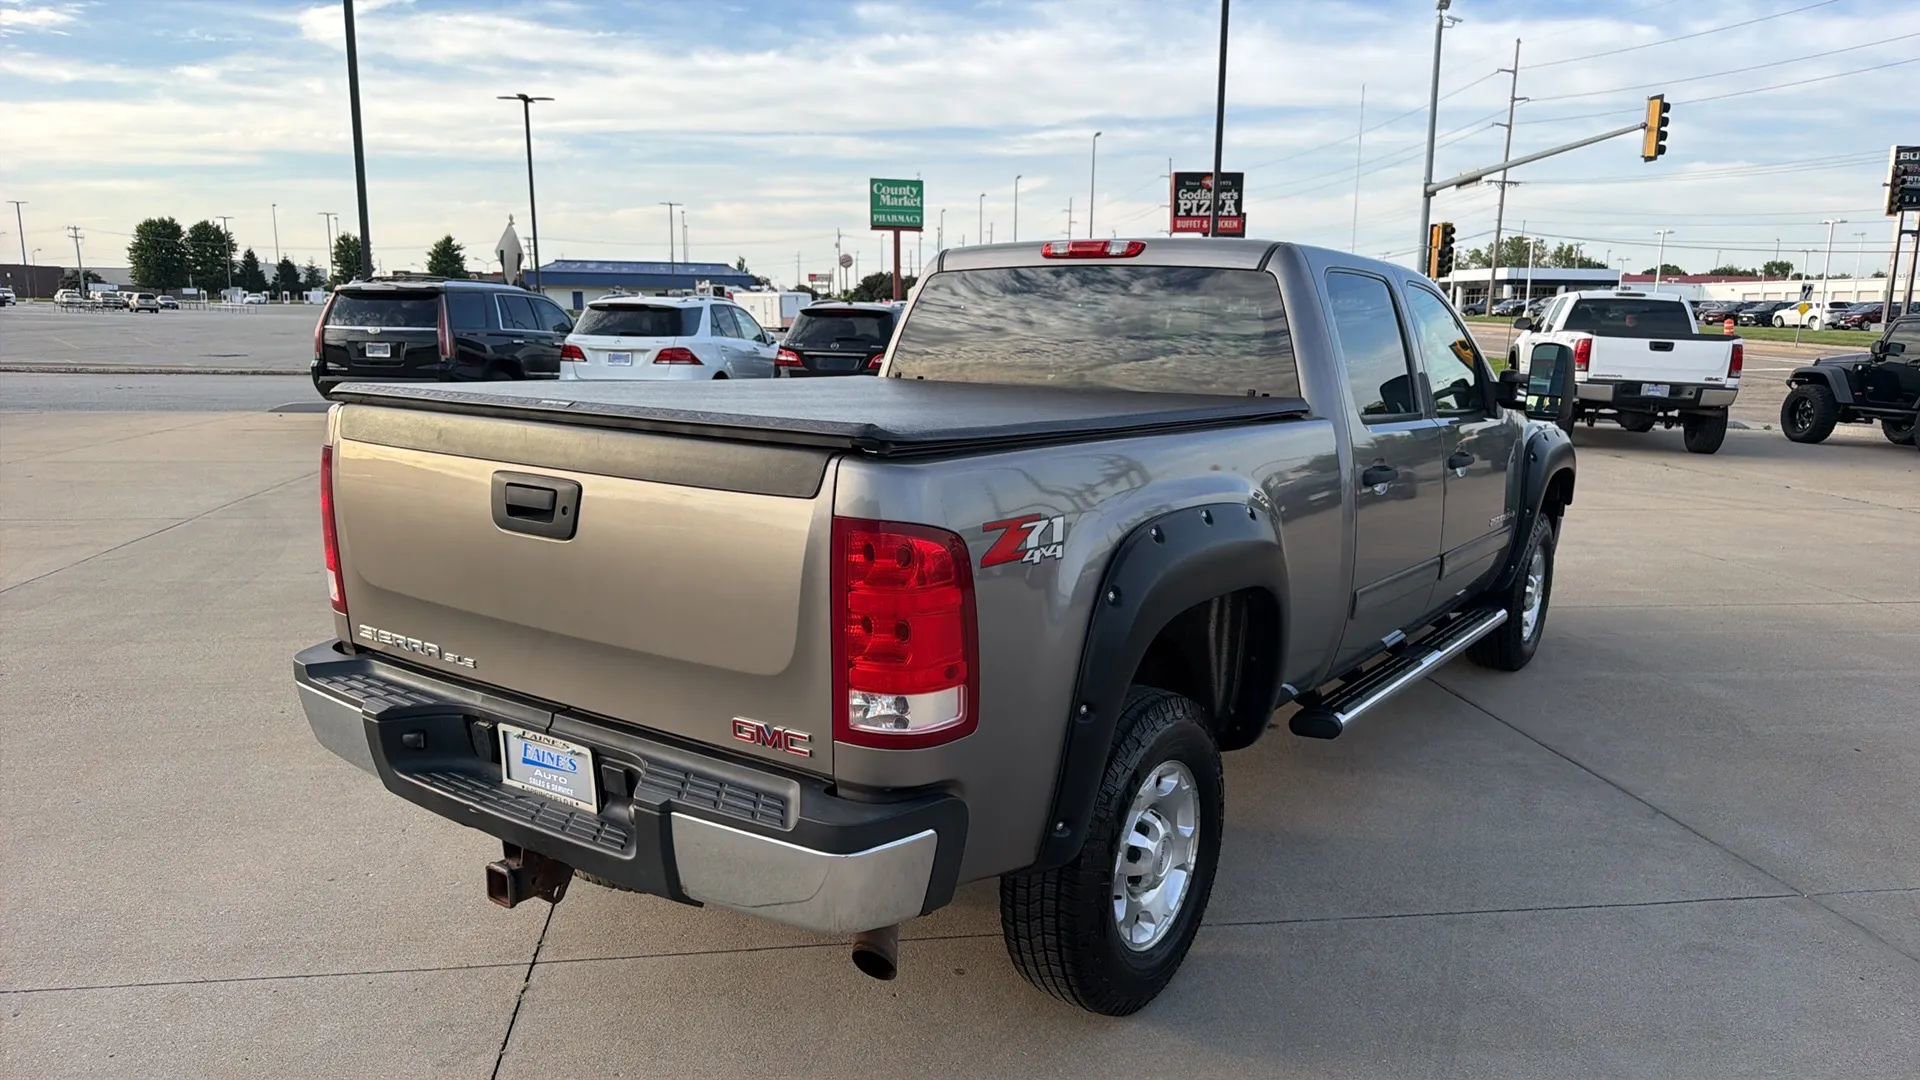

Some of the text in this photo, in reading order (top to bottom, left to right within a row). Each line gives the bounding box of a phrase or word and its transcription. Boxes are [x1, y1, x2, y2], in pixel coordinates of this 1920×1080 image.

[873, 183, 918, 197] County
[1178, 189, 1239, 200] Godfaer's
[880, 195, 921, 207] Market
[873, 215, 920, 223] PHARMACY
[1176, 220, 1200, 229] BUFFET
[1202, 220, 1208, 228] &
[980, 513, 1064, 568] Z71
[359, 624, 477, 669] SIERRA SLE
[732, 717, 812, 757] GMC
[522, 743, 577, 771] FAINE'S
[533, 769, 568, 785] AUTO
